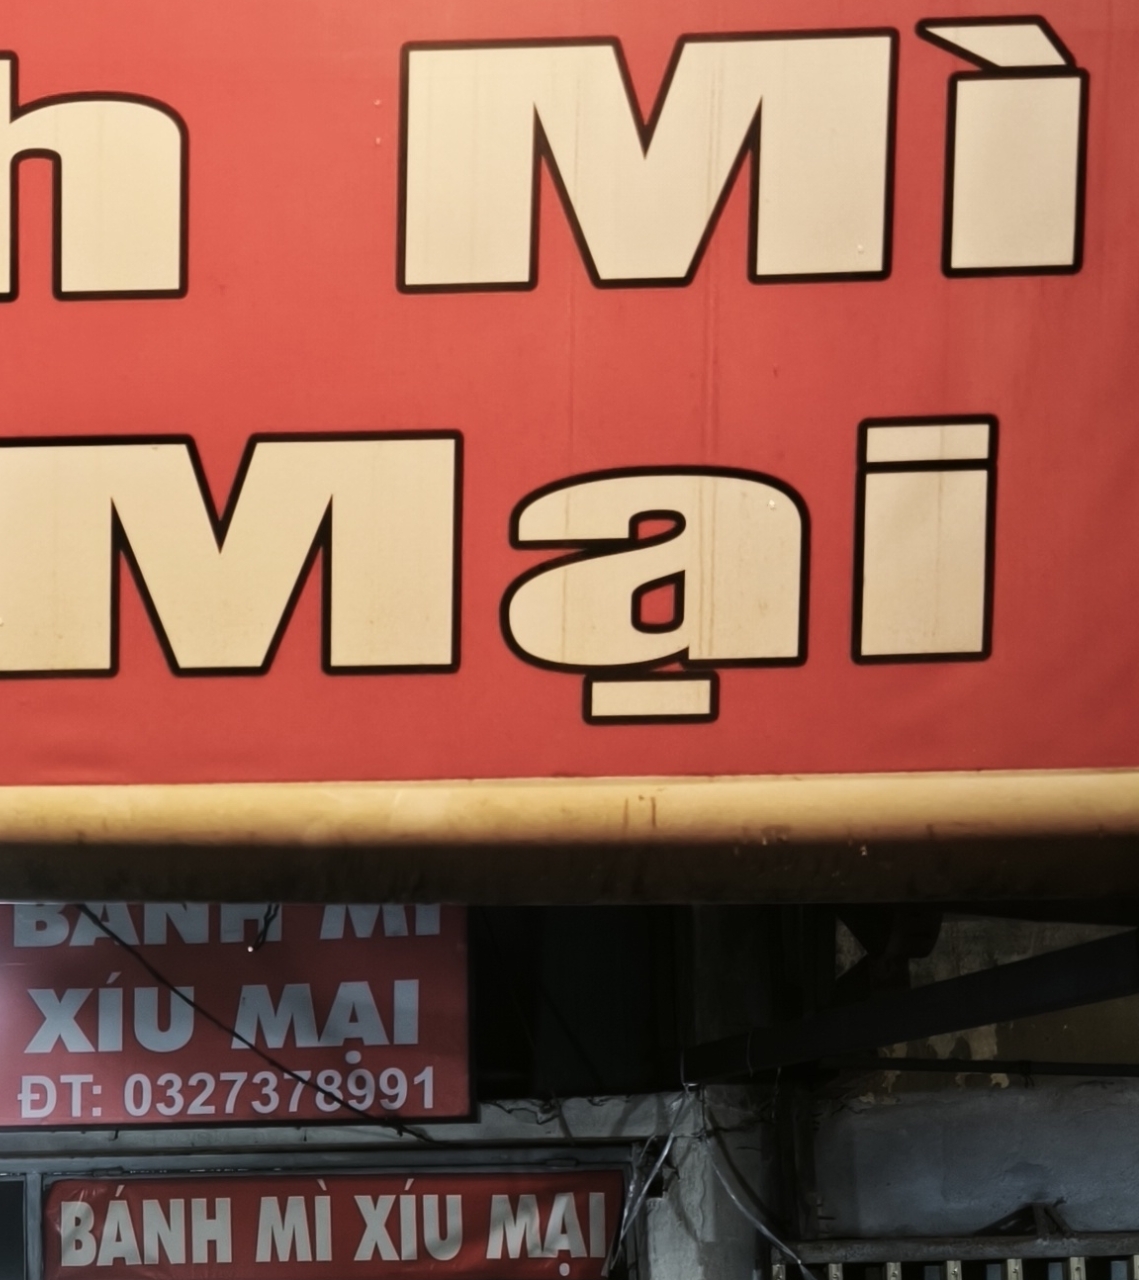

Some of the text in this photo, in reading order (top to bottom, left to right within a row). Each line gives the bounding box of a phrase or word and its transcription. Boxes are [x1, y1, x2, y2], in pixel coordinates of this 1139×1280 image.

[401, 15, 1088, 292] Mì
[24, 972, 420, 1064] XÍU MẠI
[17, 1065, 435, 1119] ĐT: 0327378991
[60, 1177, 606, 1277] BÁNH MÌ XÍU MẠI
